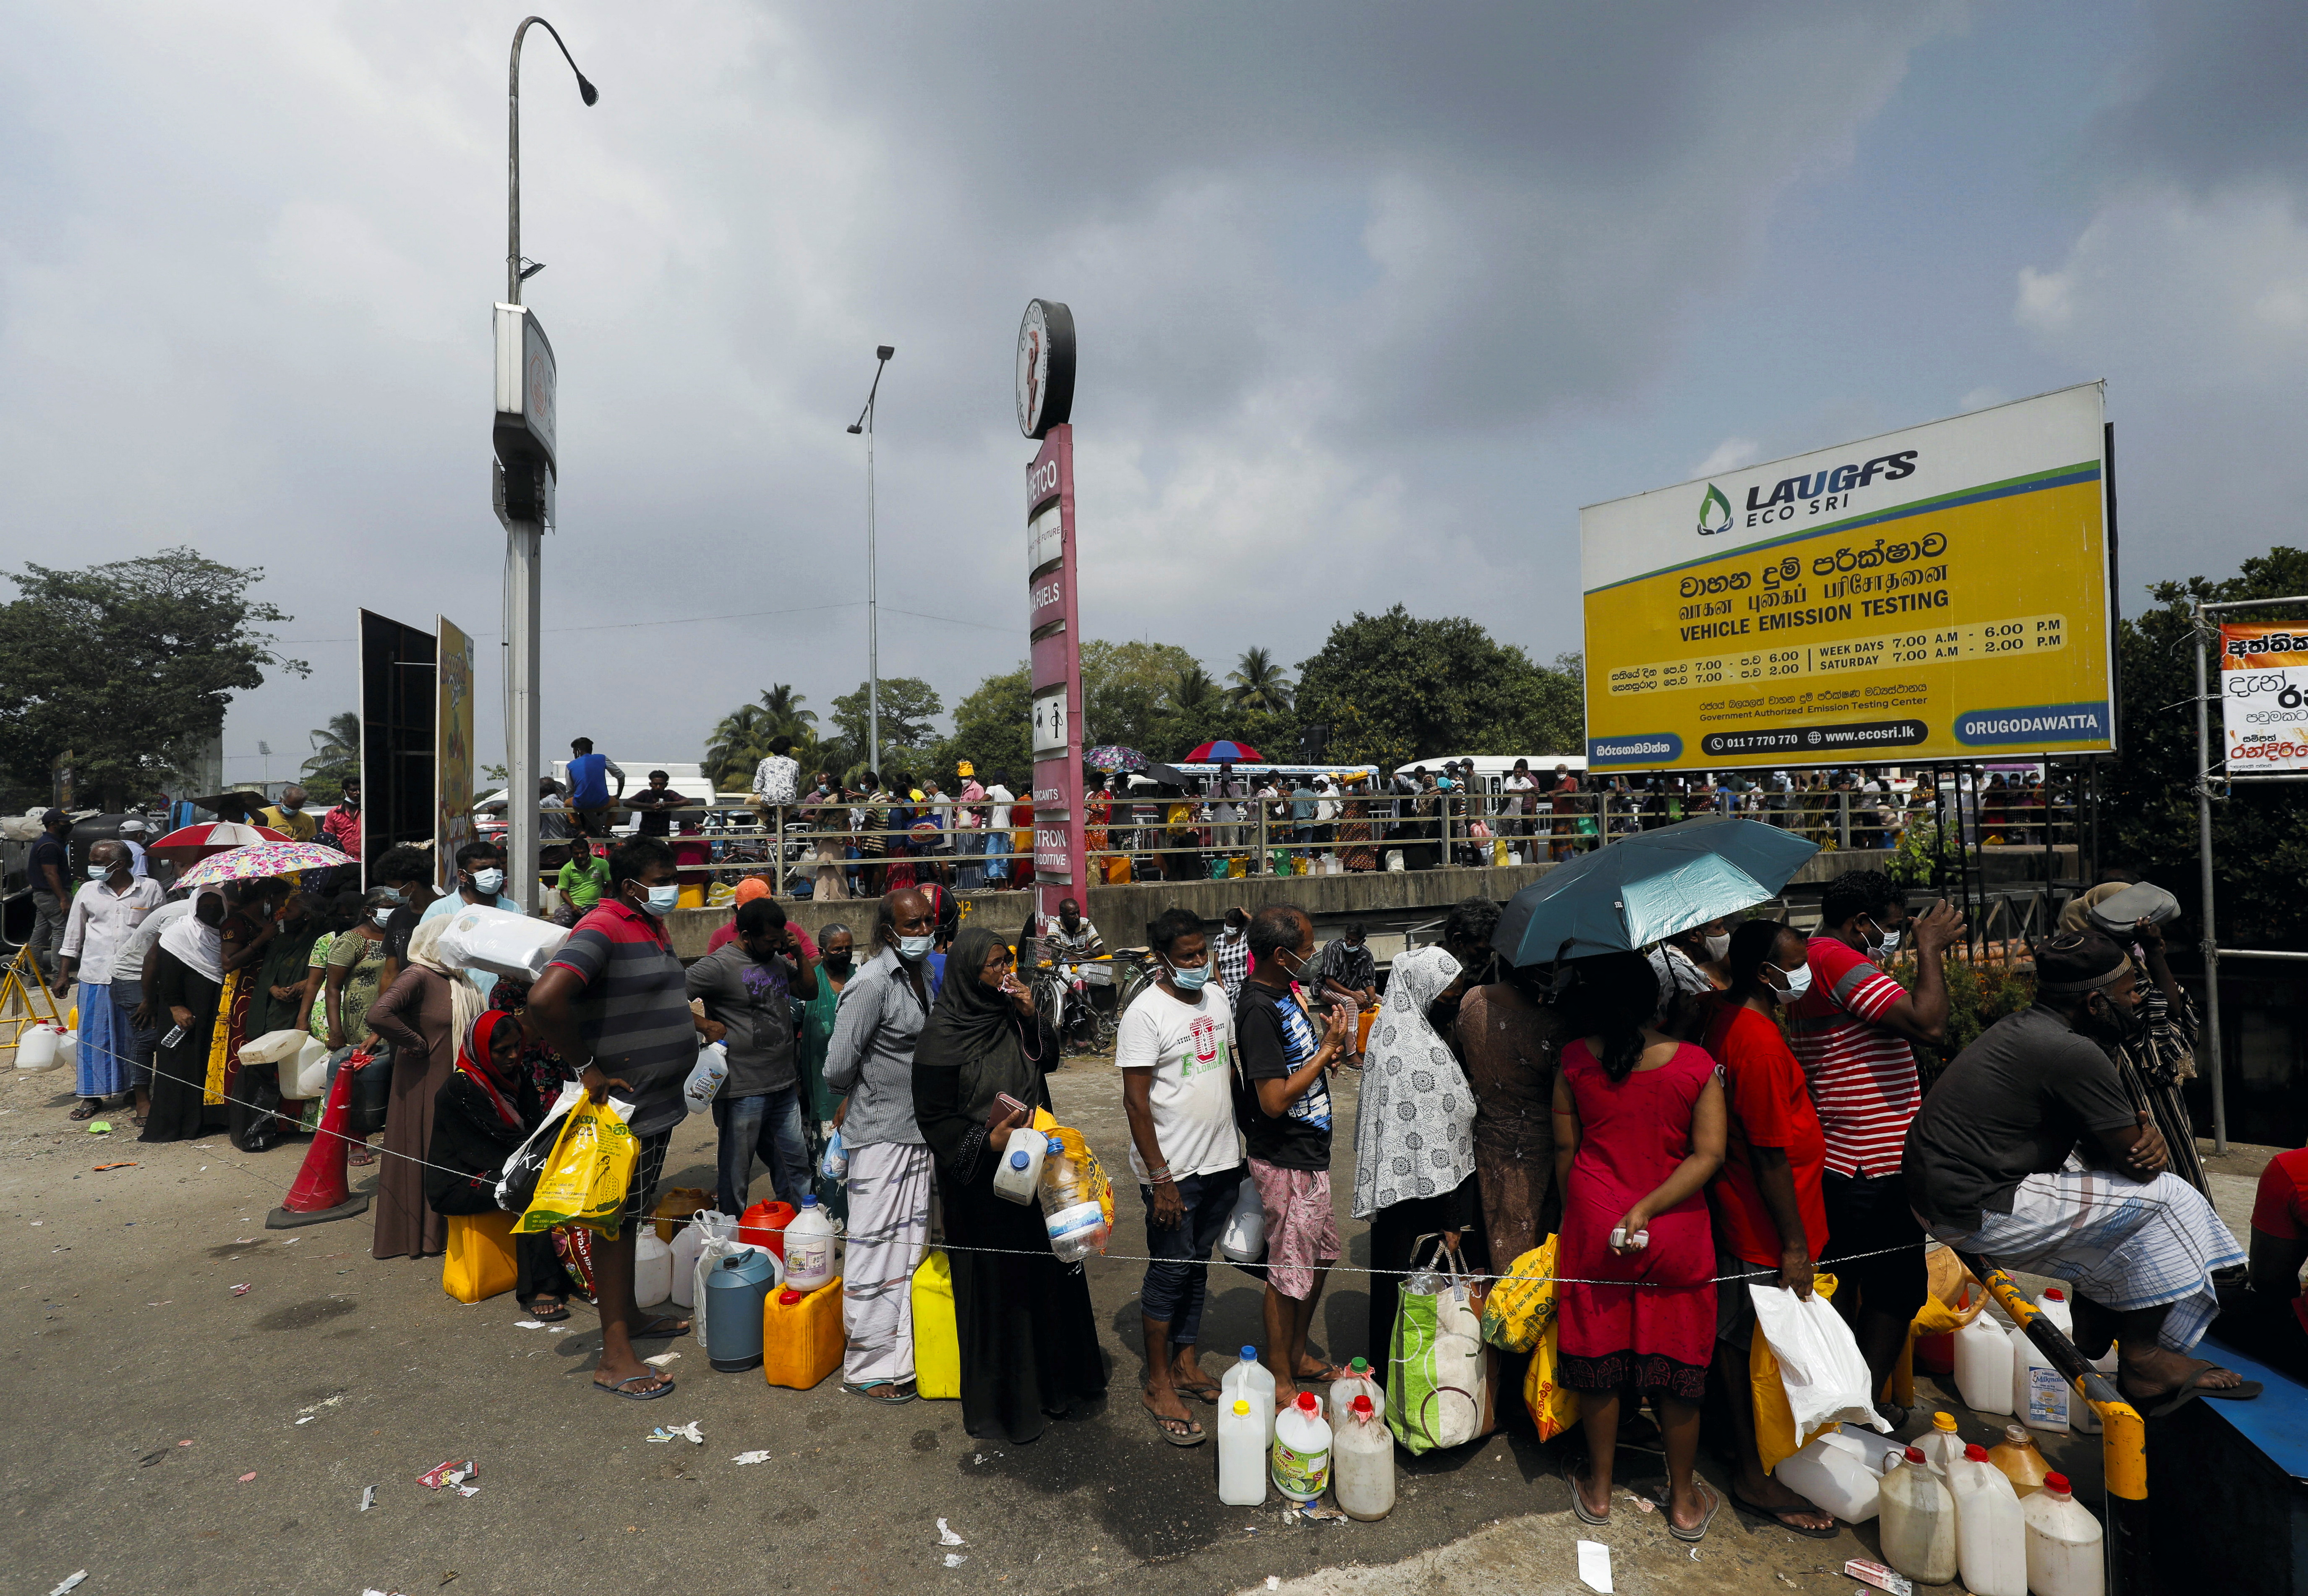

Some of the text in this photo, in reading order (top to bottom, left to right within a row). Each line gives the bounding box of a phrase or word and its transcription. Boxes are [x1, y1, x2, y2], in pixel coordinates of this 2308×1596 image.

[1746, 450, 1918, 511] LAUGFS
[1747, 493, 1848, 528] ECO SRI
[1042, 525, 1060, 543] FUTURE
[1679, 532, 1948, 598] වාහන දුම් පරීක්ෂාව
[1037, 582, 1059, 610] FUELS
[1679, 564, 1949, 621] வாகன புகைப் பரிசோதனை
[1679, 589, 1949, 643] VEHICLE EMISSION TESTING
[1820, 645, 1851, 657] WEEK
[1855, 641, 1884, 653] DAYS
[1893, 635, 1927, 648] 7.00
[1935, 632, 1958, 644] A.M
[1984, 623, 2023, 637] 6.00
[2036, 619, 2061, 632] P.M
[1820, 655, 1879, 671] SATURDAY
[1893, 649, 1927, 662] 7.00
[1935, 646, 1958, 658] A.M
[1984, 638, 2024, 653] 2.00
[2037, 635, 2061, 647] P.M
[1611, 669, 1640, 681] සතියේ
[1642, 668, 1657, 678] දින
[1663, 664, 1688, 675] පෙ.ව
[1695, 660, 1722, 671] 7.00
[1741, 656, 1761, 666] ප.ව
[1769, 651, 1799, 662] 6.00
[1612, 681, 1657, 692] සෙනසුරාදා
[1663, 676, 1688, 687] පෙ.ව
[1696, 672, 1722, 683] 7.00
[1741, 668, 1761, 678] ප.ව
[1769, 664, 1799, 675] 2.00
[2229, 670, 2286, 698] දැන්
[1700, 701, 1725, 711] රජයේ
[1769, 695, 1795, 705] වාහන
[1800, 692, 1813, 704] දුම්
[1700, 696, 1928, 721] Government Authorized Emission Testing Center
[1727, 725, 1914, 748] 011 7 770 770 www.ecosri.lk
[1966, 715, 2098, 735] ORUGODAWATTA
[1596, 742, 1670, 756] ඔරුගොඩවත්ත
[2243, 734, 2277, 742] සම්පත්
[450, 817, 465, 838] UP TO
[695, 1082, 713, 1093] Sanitizer
[698, 1078, 710, 1088] Hand
[577, 1230, 587, 1255] CYCLE
[1275, 1452, 1289, 1468] Lime
